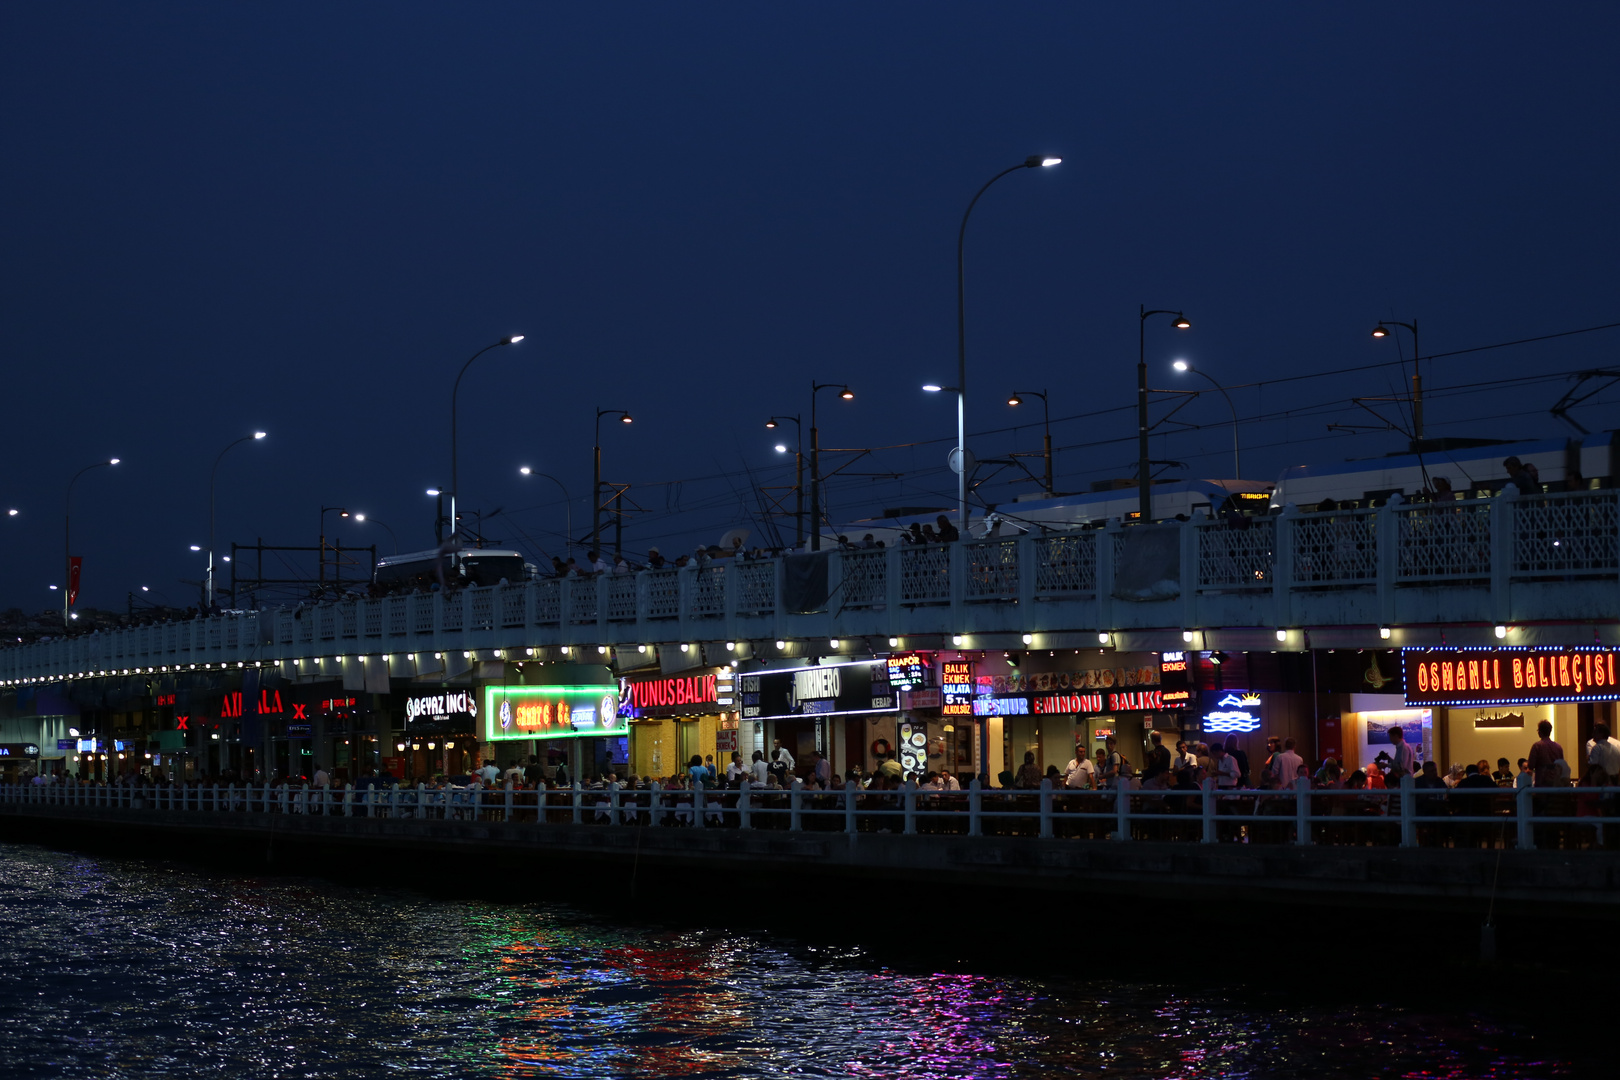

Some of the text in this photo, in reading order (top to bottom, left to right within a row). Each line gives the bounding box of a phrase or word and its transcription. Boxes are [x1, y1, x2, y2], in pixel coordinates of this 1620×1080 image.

[1163, 652, 1184, 662] BALIK
[945, 664, 969, 674] BALIK
[1162, 661, 1187, 672] EKMEK
[1418, 653, 1616, 693] OSMANLI BALIKÇISI
[743, 675, 760, 693] FISH
[795, 668, 841, 700] MARINERO
[943, 674, 970, 684] EKMEK
[943, 684, 970, 694] SALATA
[871, 698, 891, 708] KEBAP
[945, 694, 954, 704] 5
[957, 697, 969, 705] TL
[1033, 691, 1103, 714] EMİNÖNÜ
[413, 695, 445, 716] BEYAZ
